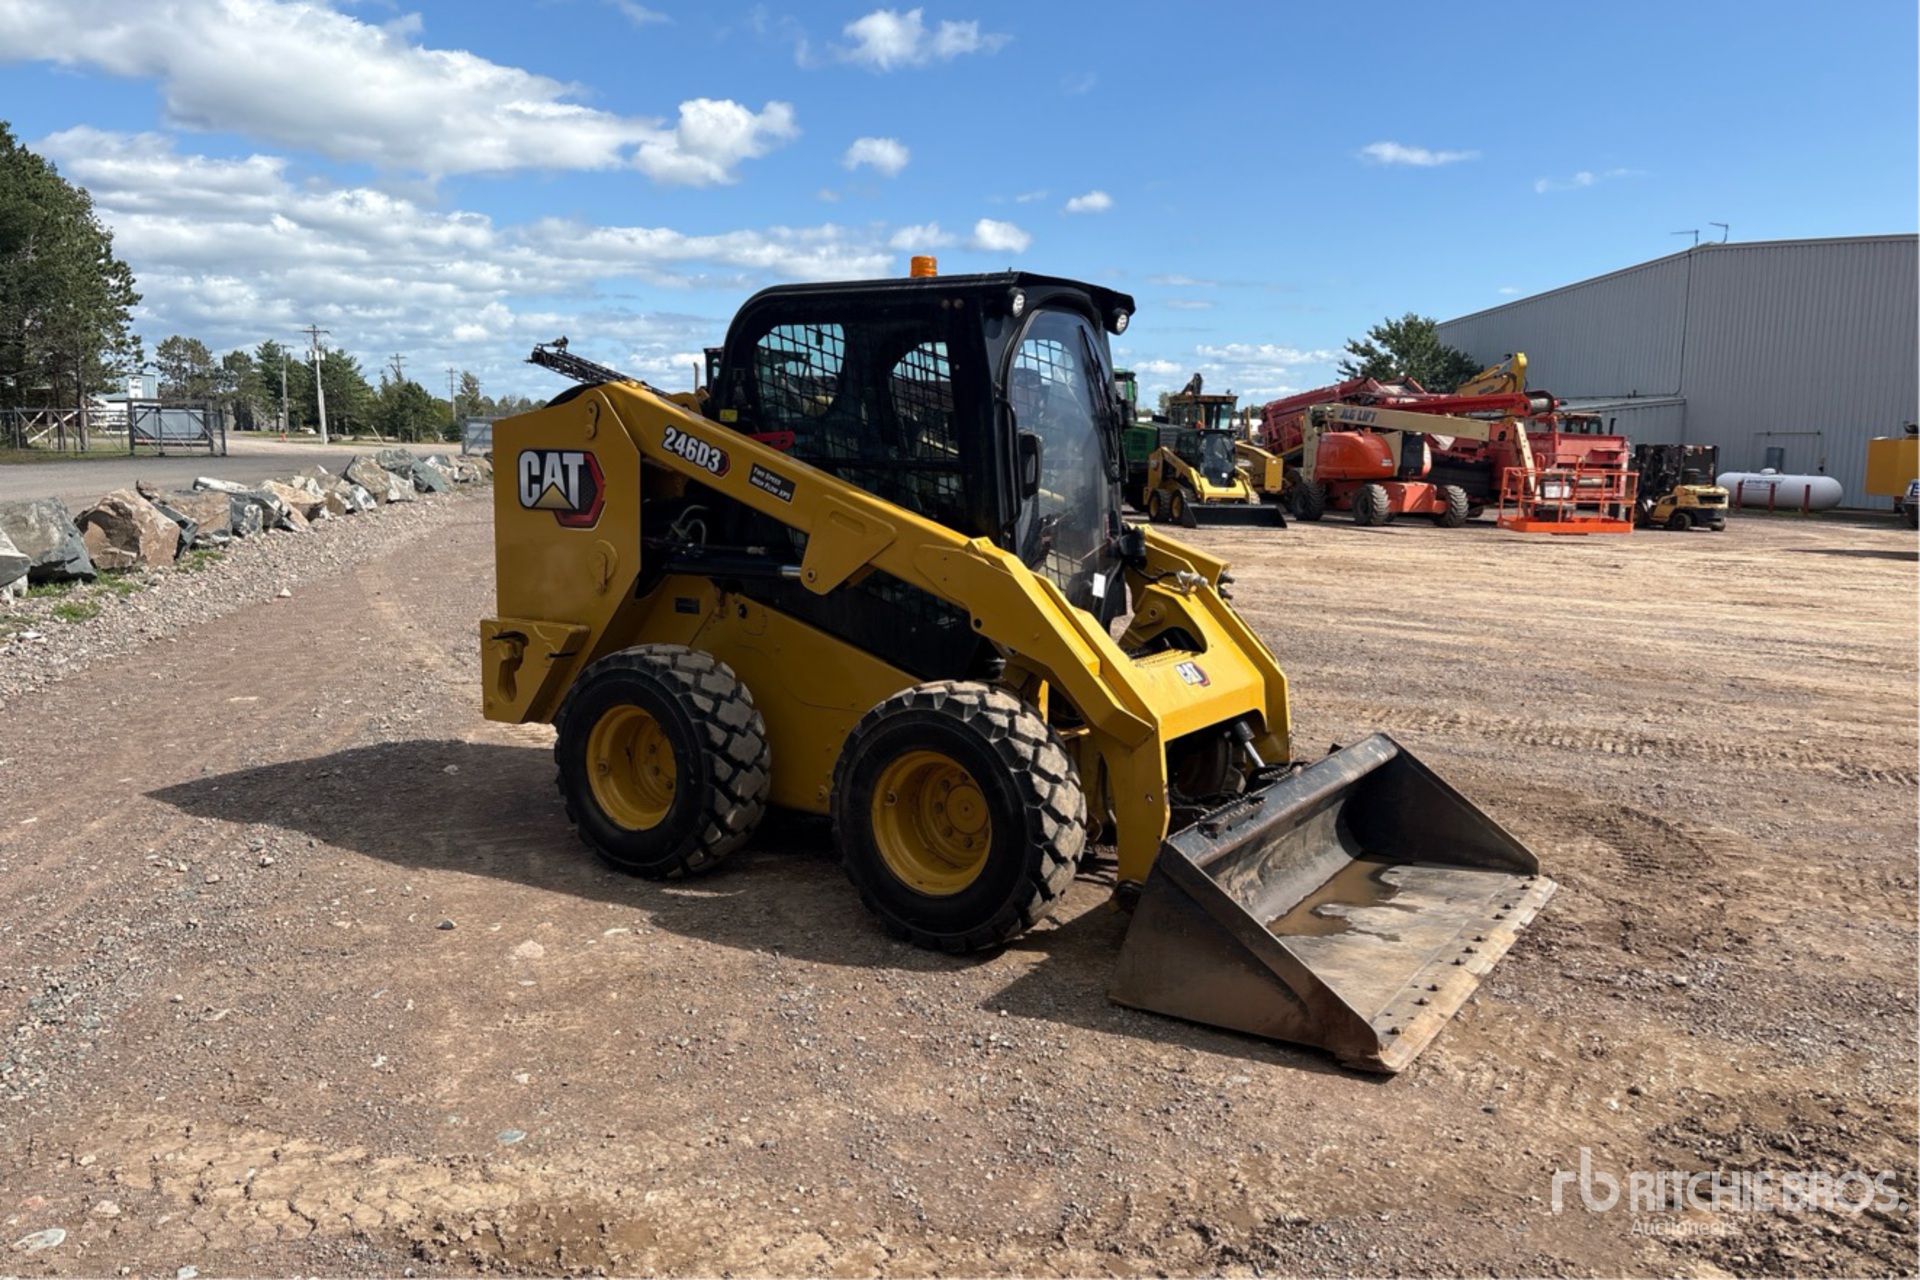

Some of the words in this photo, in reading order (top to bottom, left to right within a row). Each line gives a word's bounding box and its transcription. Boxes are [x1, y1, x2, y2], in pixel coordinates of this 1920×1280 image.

[1357, 409, 1377, 423] LIFT
[662, 426, 721, 473] 246D3
[519, 451, 584, 509] CAT
[1175, 662, 1204, 685] CAT
